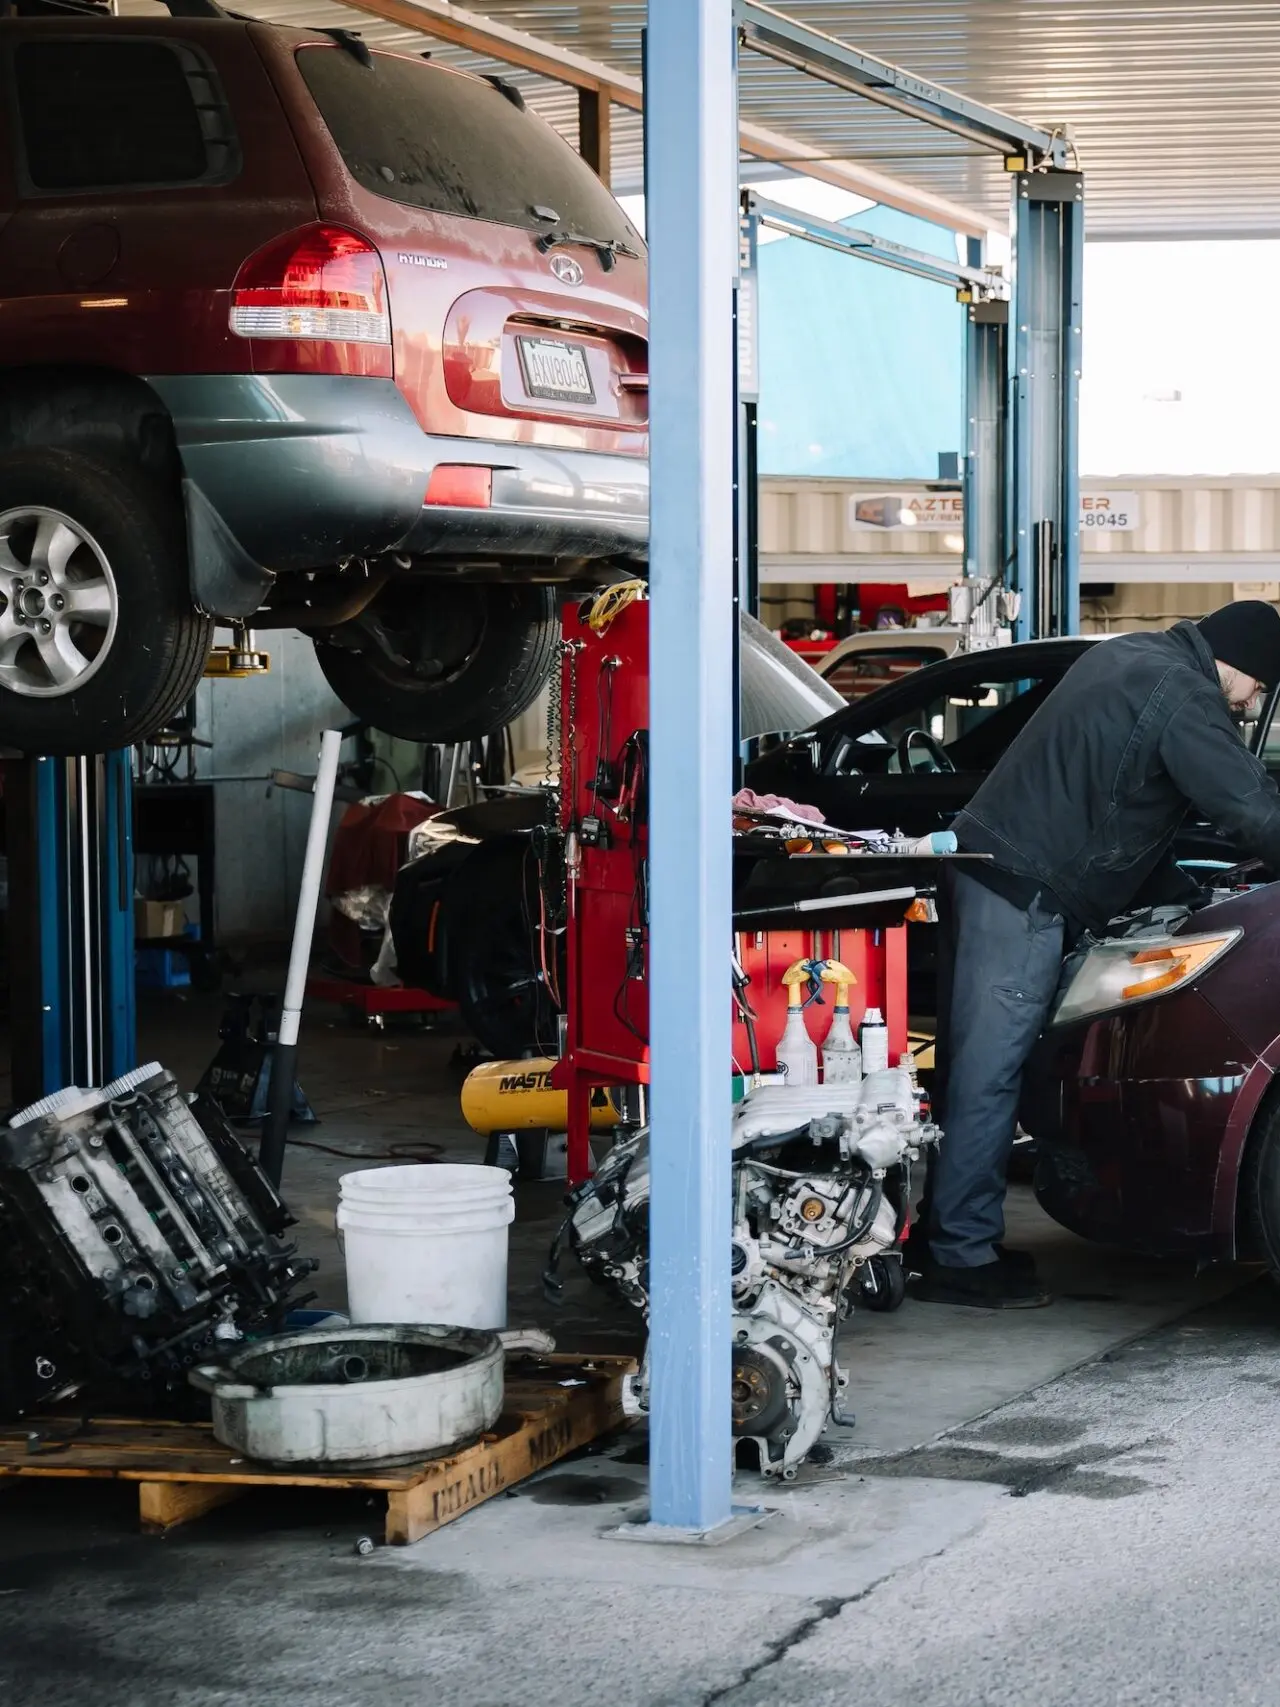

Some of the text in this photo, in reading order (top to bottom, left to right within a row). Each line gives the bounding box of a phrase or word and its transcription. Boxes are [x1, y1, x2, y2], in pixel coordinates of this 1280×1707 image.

[398, 252, 448, 270] HYUNDAI
[531, 353, 587, 389] AXV8048
[908, 497, 1110, 511] AZTE ER
[1078, 513, 1128, 526] -8045
[499, 1072, 553, 1091] MASTE
